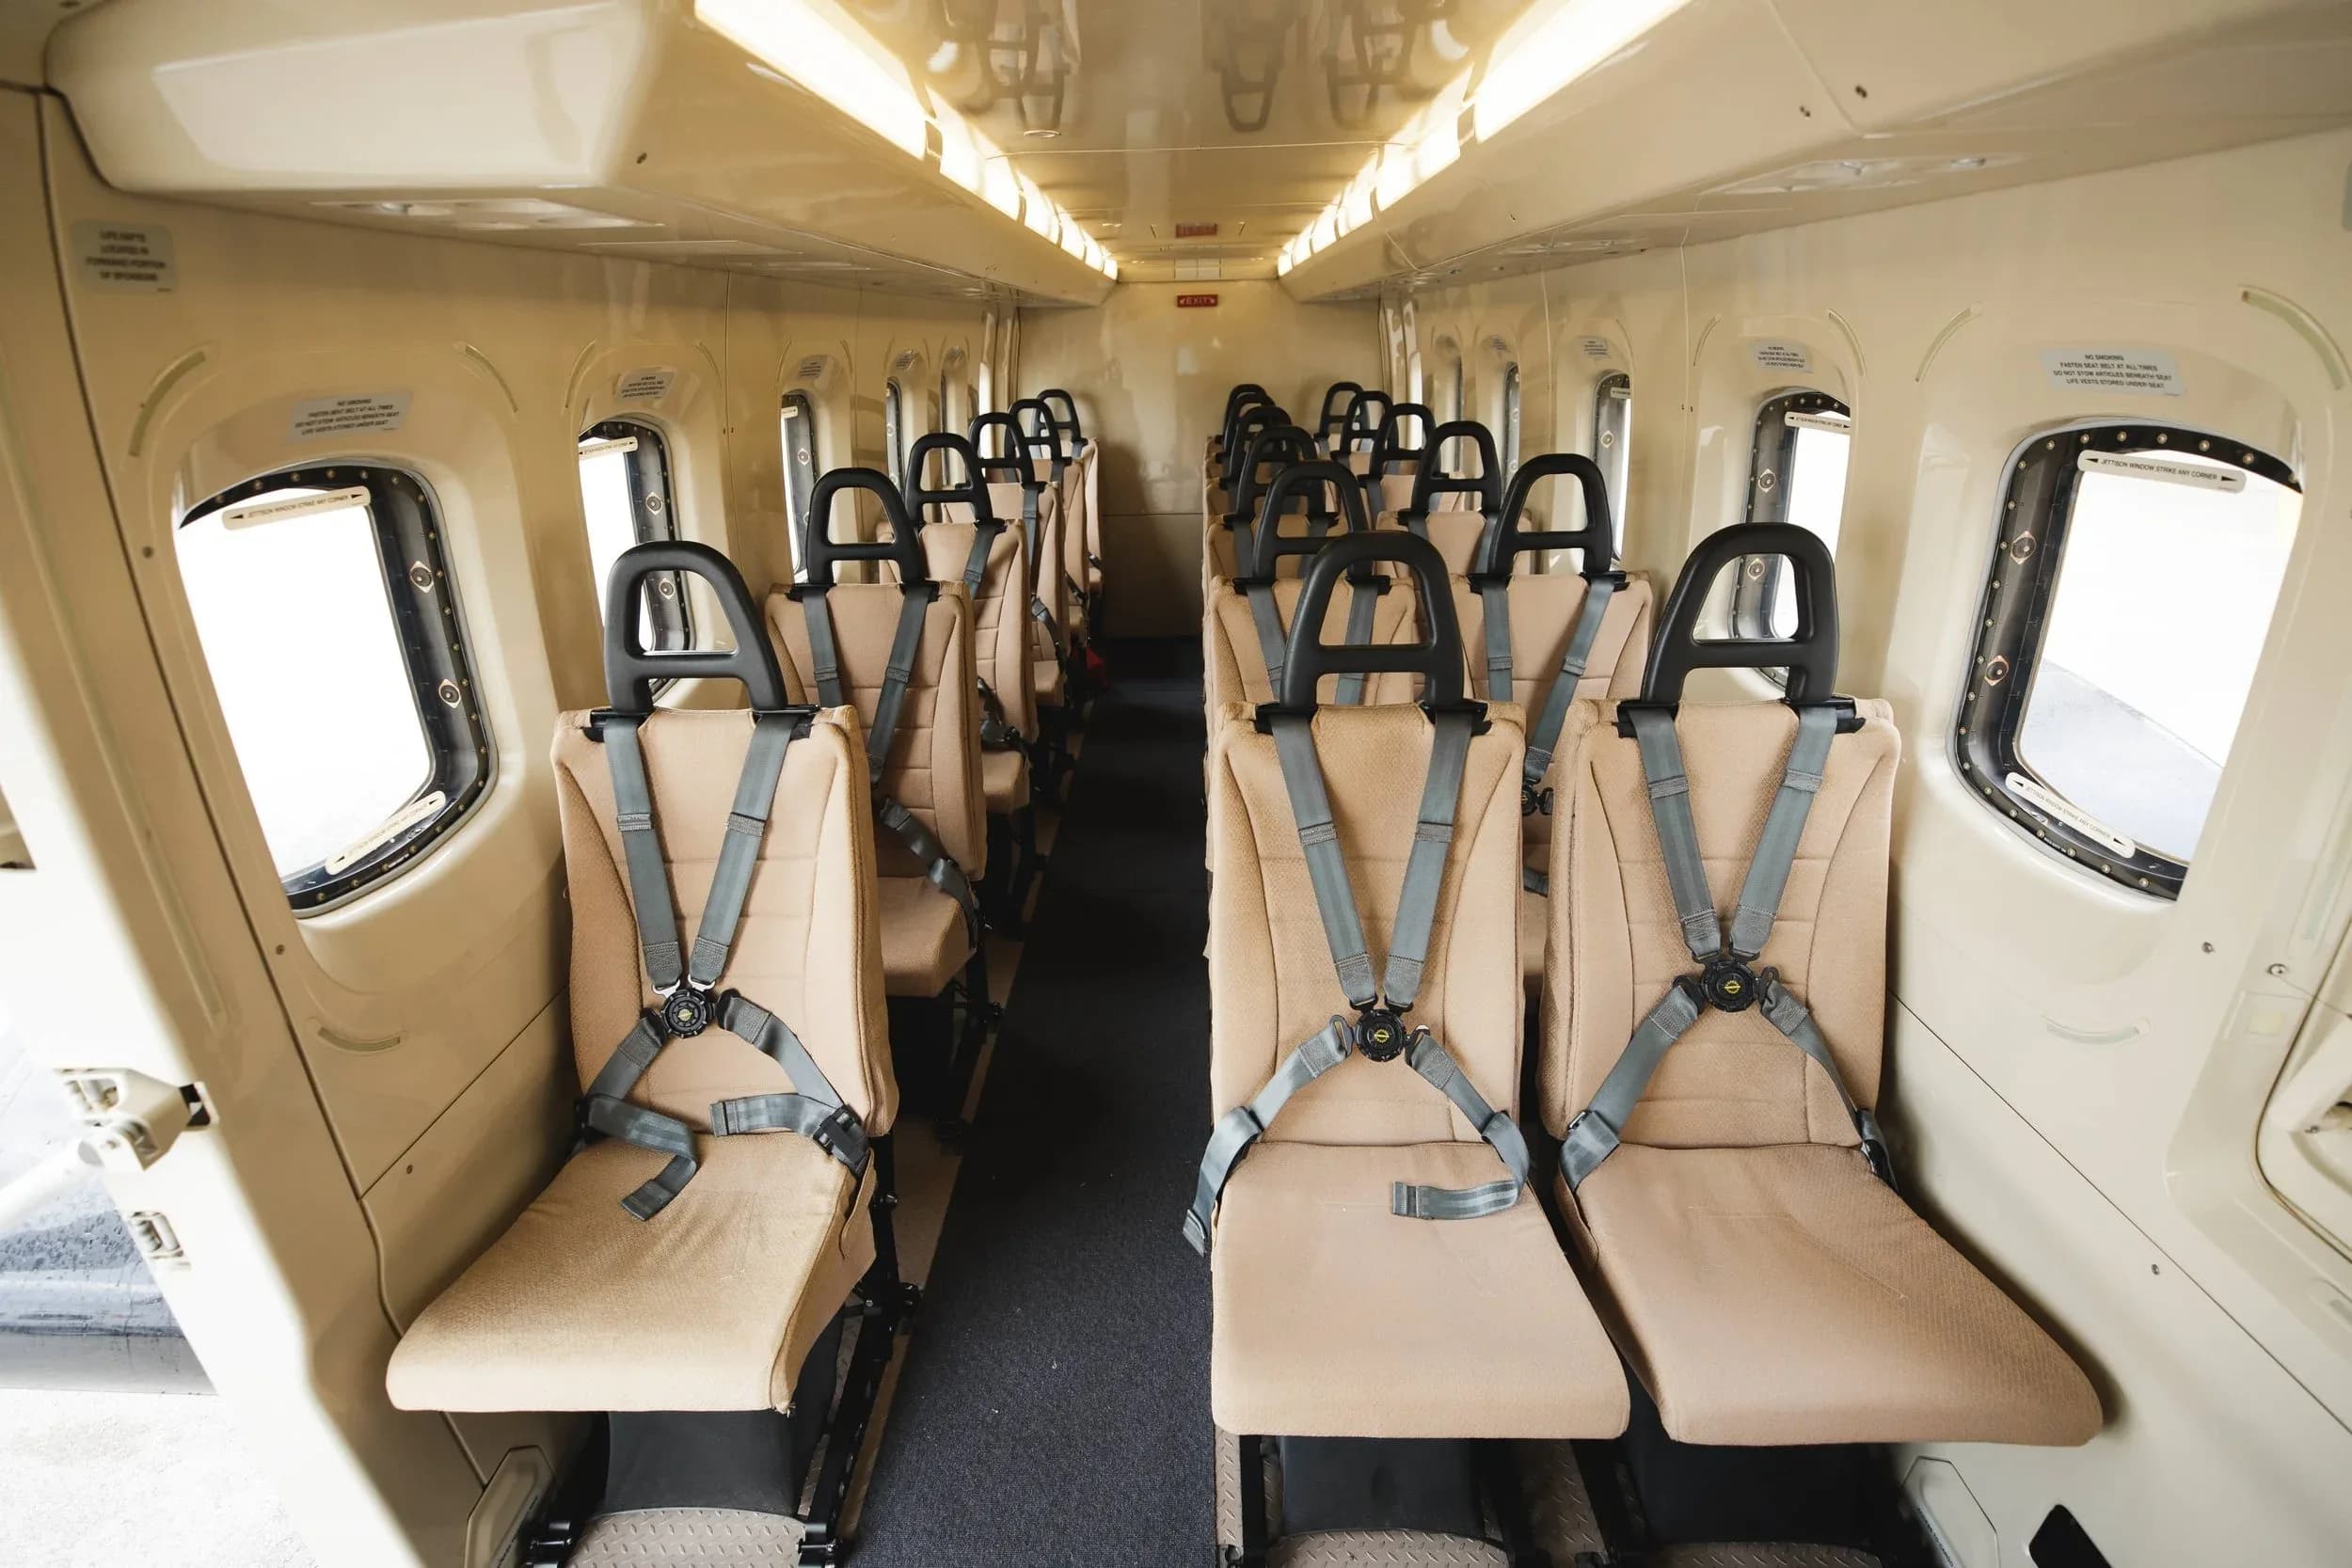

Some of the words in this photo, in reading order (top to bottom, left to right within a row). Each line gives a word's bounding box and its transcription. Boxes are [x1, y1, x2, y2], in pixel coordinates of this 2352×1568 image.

[2101, 458, 2128, 467] JETTISON
[2129, 463, 2154, 471] WINDOW
[2155, 466, 2176, 474] STRIKE
[2192, 470, 2217, 480] CORNER
